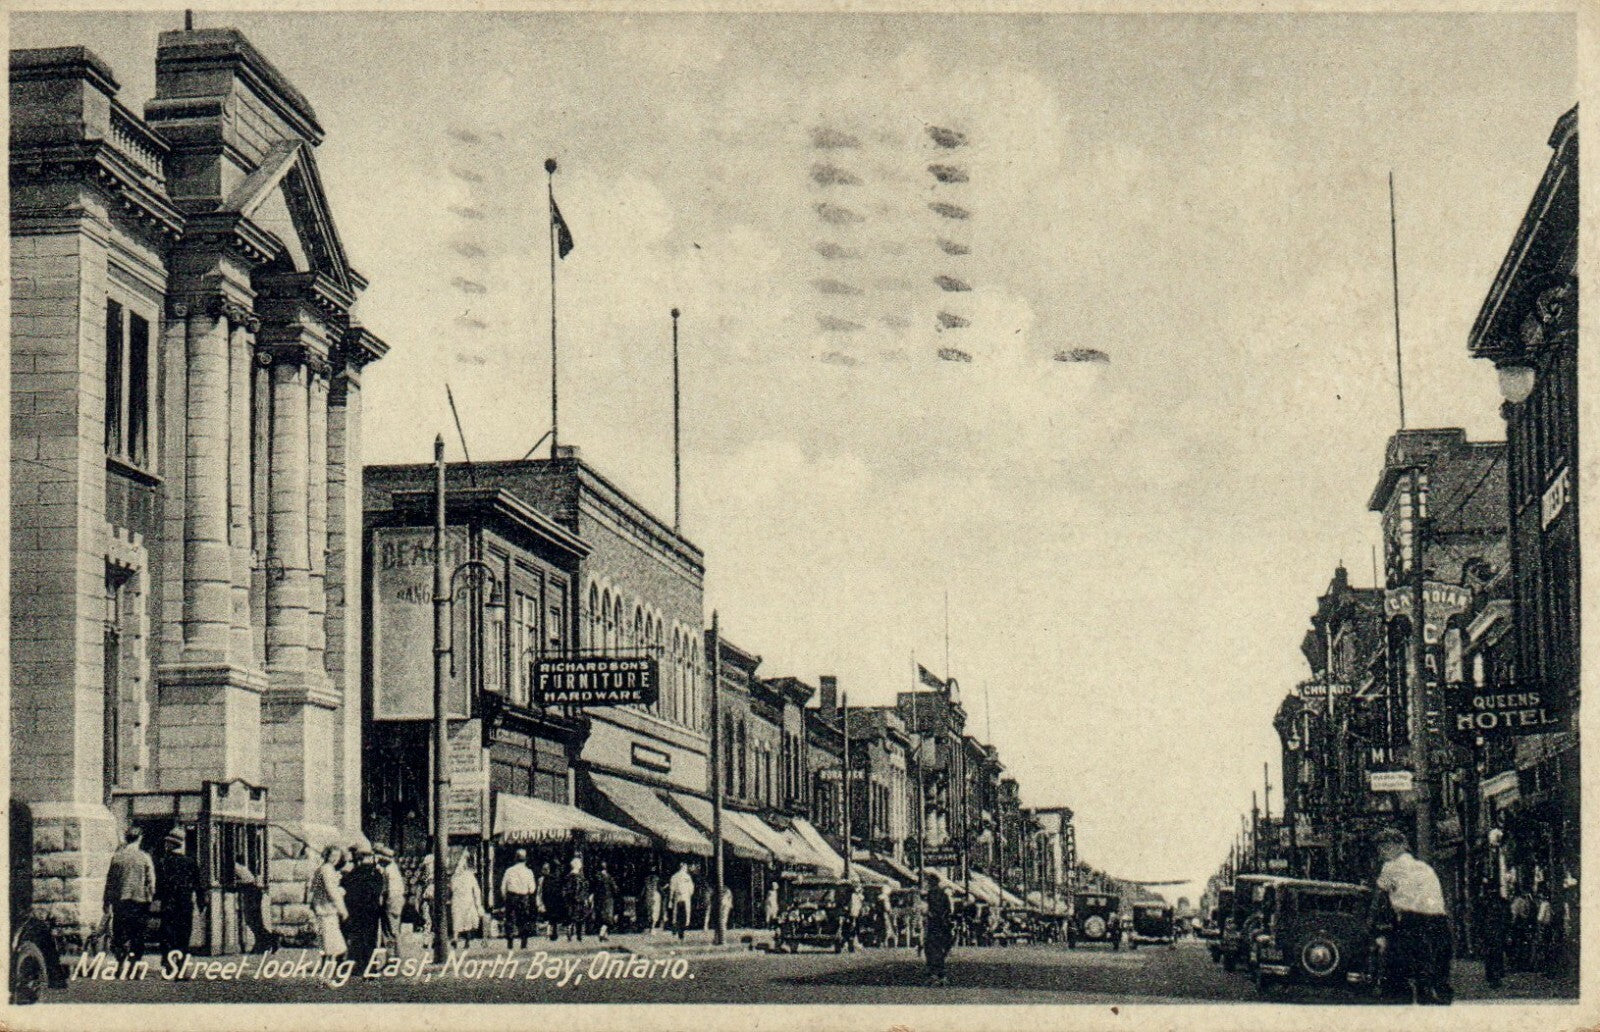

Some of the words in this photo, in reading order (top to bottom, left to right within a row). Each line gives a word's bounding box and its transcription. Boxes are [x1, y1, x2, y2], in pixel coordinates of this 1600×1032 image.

[540, 672, 650, 690] FURNITURE
[544, 690, 641, 701] HARDWARE
[1473, 692, 1540, 710] QUEENS
[1457, 709, 1558, 730] HOTEL
